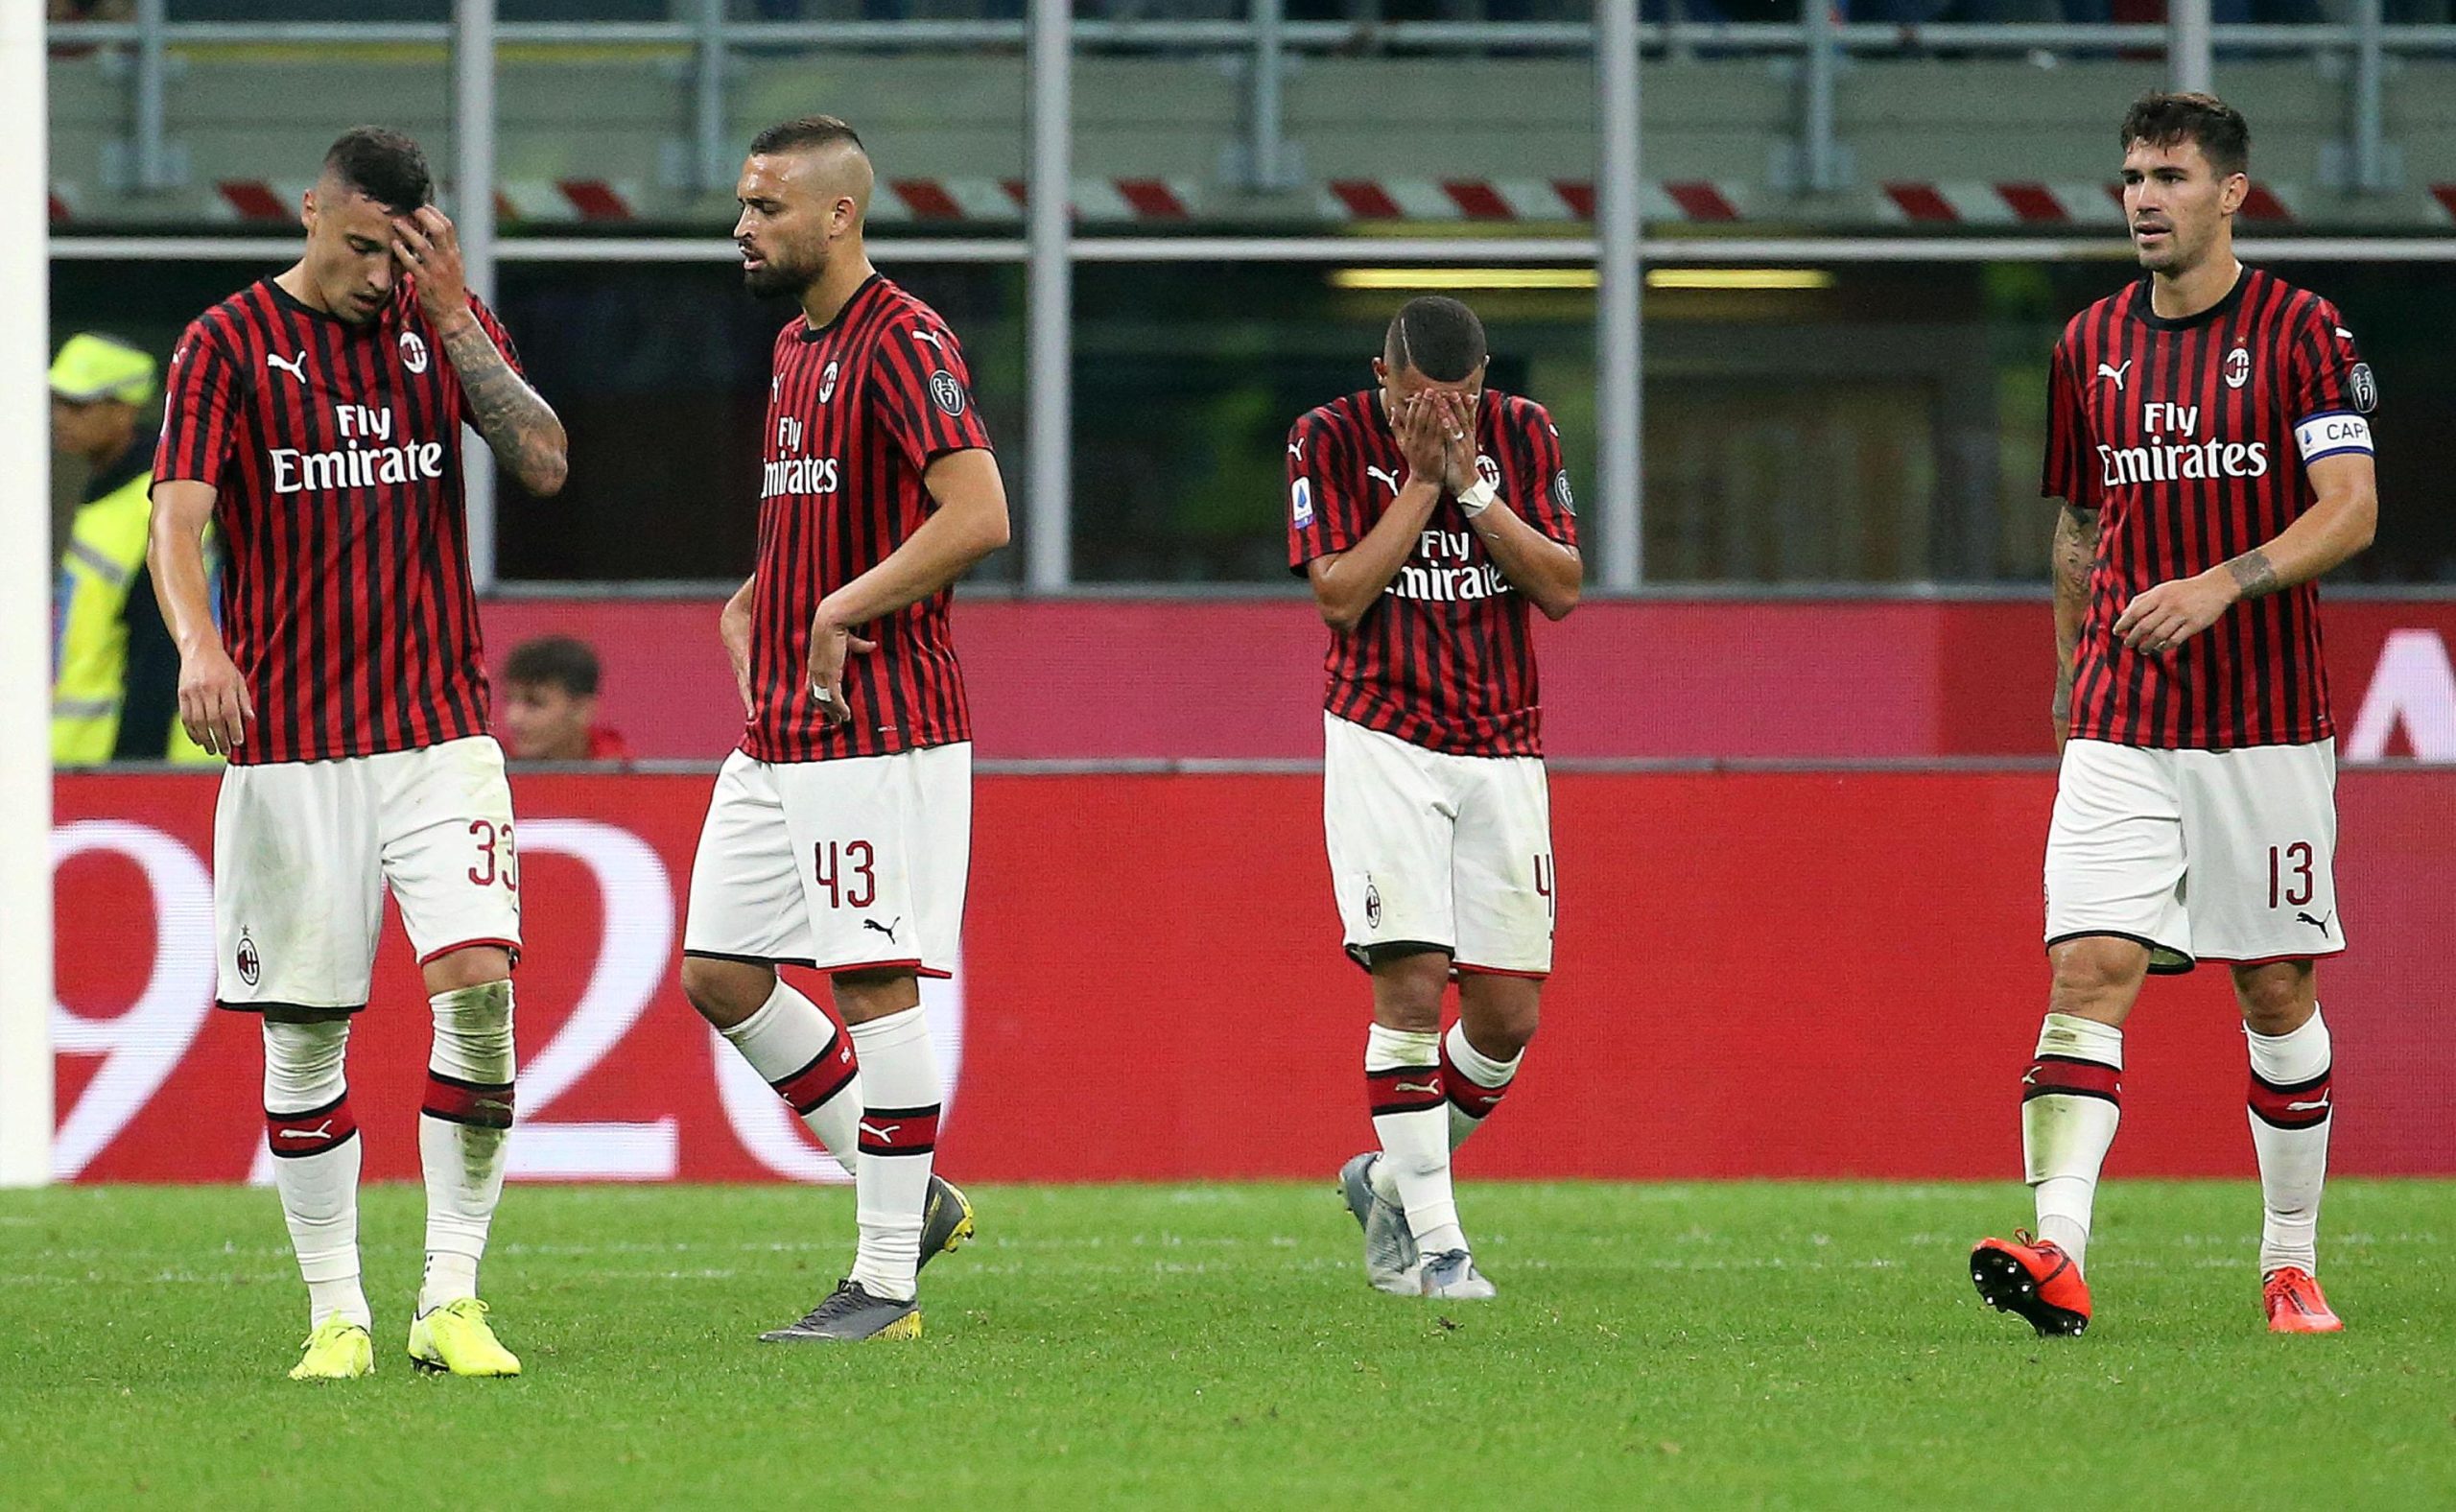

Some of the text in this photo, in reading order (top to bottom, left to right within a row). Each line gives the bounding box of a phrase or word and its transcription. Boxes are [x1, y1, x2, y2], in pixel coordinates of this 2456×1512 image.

[336, 404, 390, 441] Fly
[778, 415, 803, 453] Fly
[2144, 402, 2198, 437] Fly
[269, 438, 443, 493] Emirate
[760, 449, 838, 499] mirates
[2096, 435, 2267, 486] Emirates
[1421, 530, 1470, 561] Fly
[1384, 559, 1515, 602] mirate
[468, 819, 516, 891] 33
[815, 840, 875, 909] 43
[2269, 841, 2313, 910] 13
